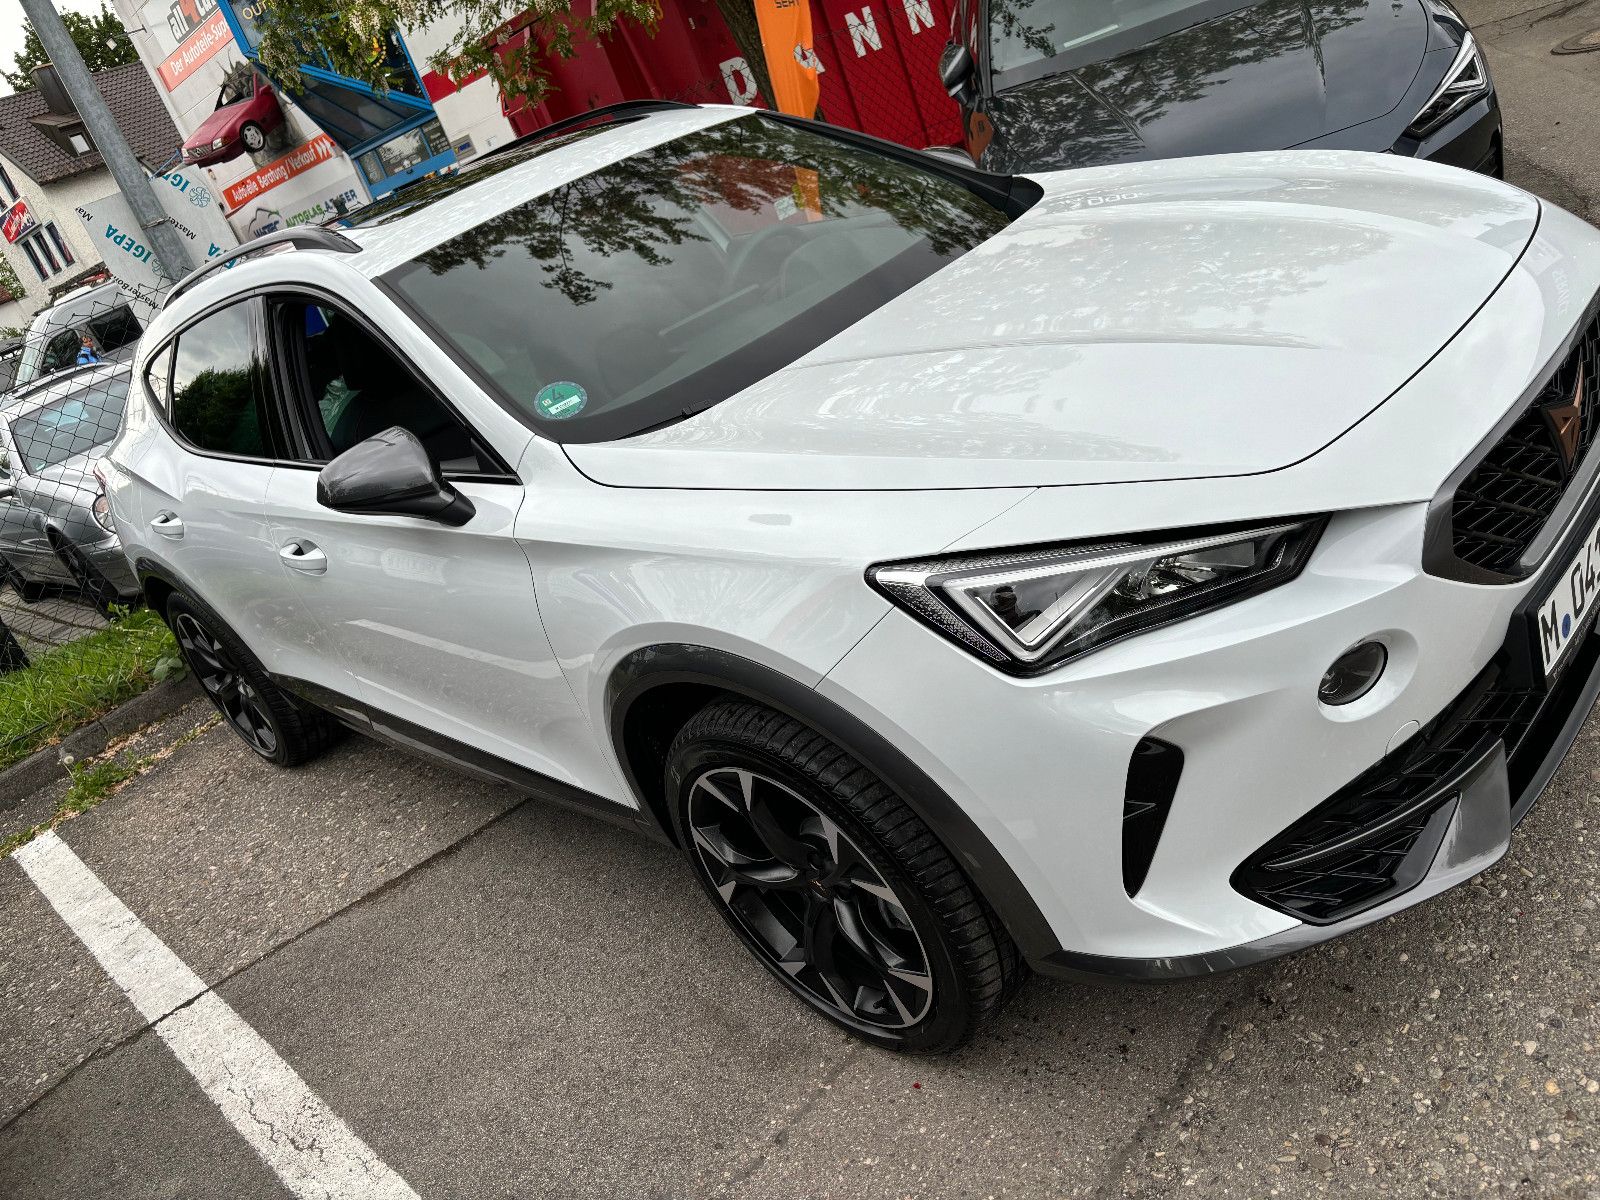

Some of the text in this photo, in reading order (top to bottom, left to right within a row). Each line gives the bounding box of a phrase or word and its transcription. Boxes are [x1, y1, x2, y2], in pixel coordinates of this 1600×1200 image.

[170, 56, 184, 76] Der
[104, 223, 154, 264] IGEPA
[1540, 599, 1561, 666] M
